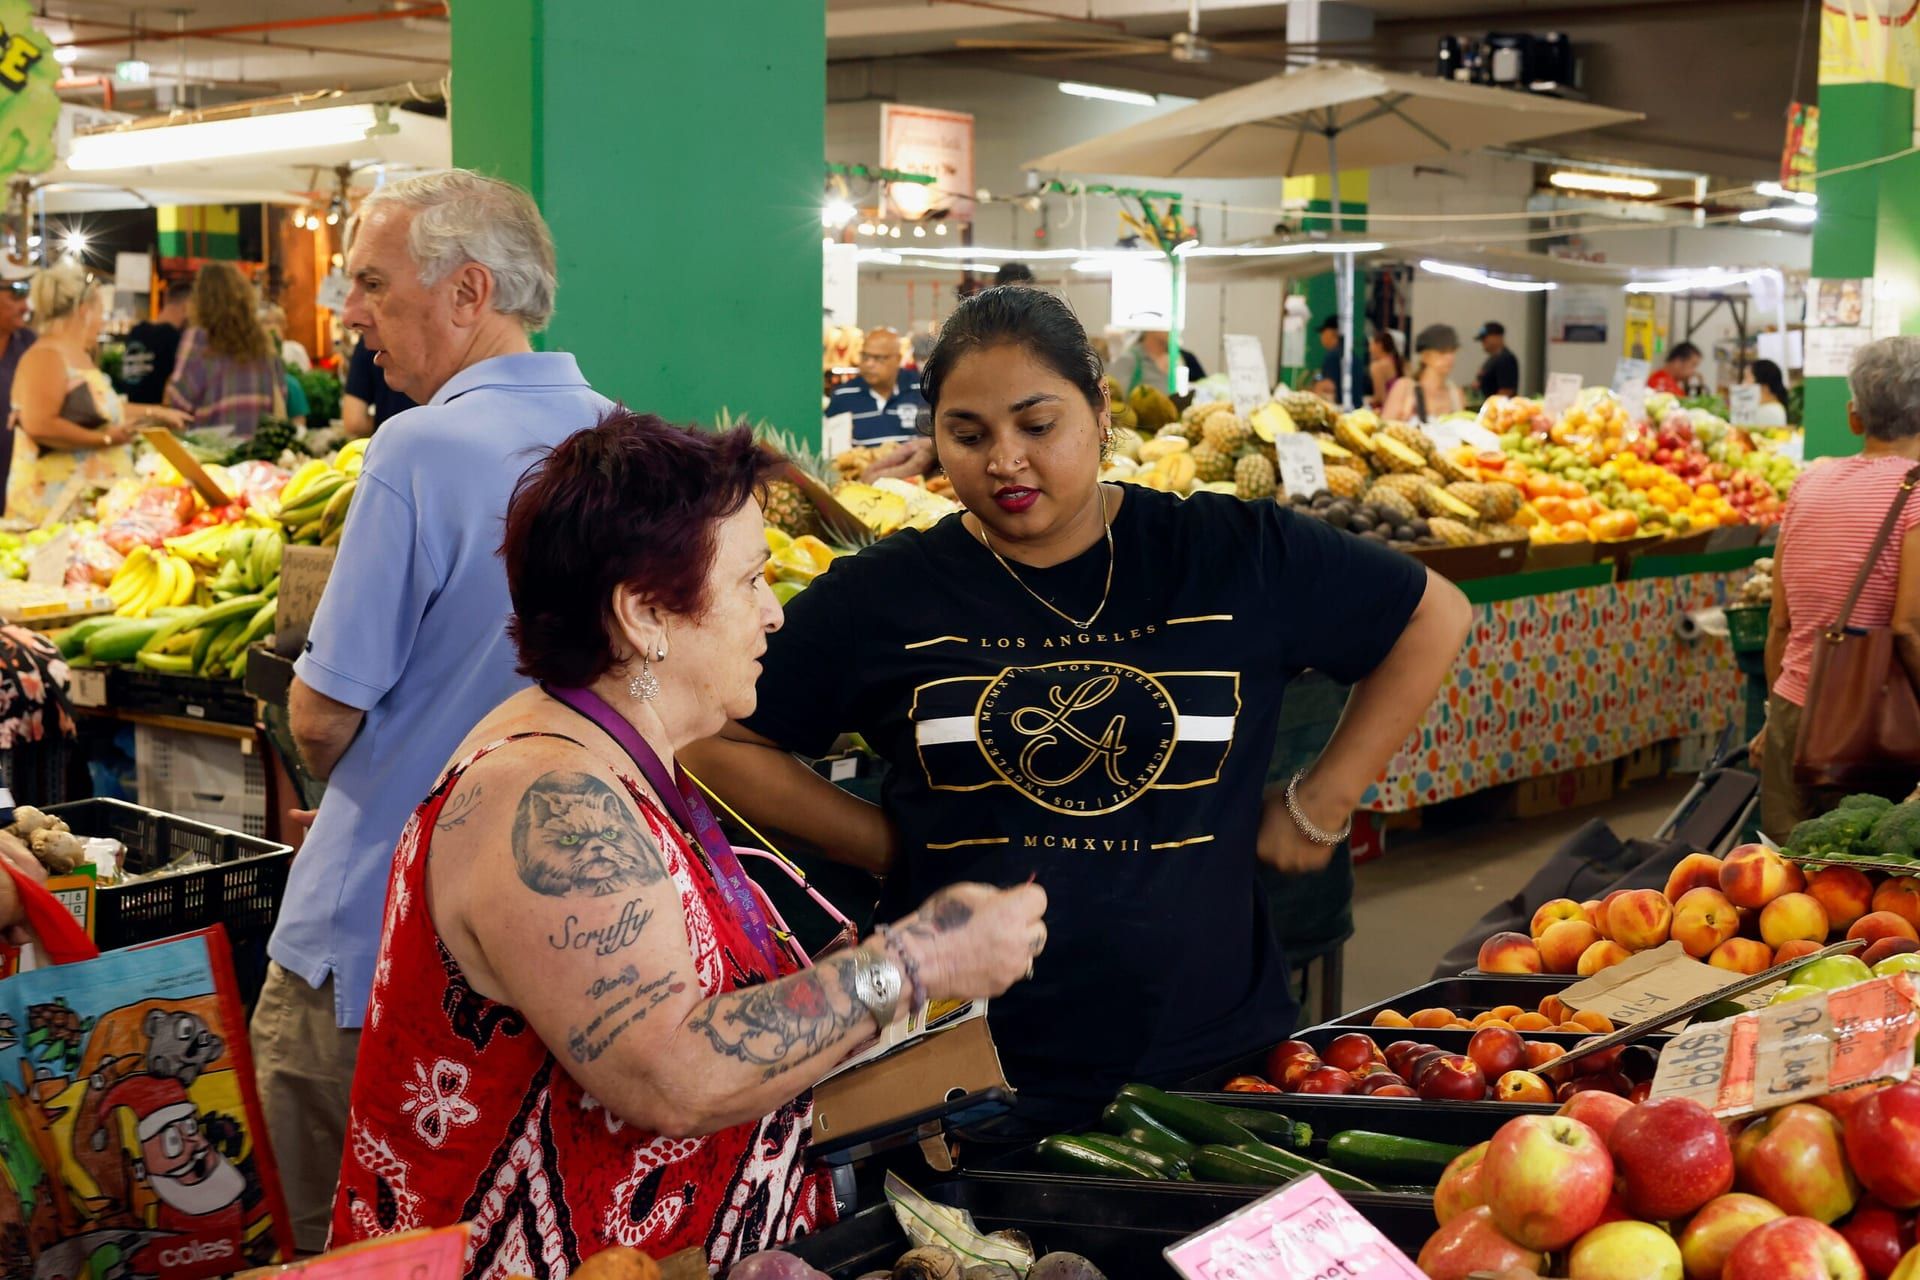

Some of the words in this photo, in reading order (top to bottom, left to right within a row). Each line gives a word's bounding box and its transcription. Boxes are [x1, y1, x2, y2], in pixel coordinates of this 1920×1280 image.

[980, 637, 1026, 648] LOS
[1043, 624, 1156, 648] ANGELES
[1057, 664, 1091, 672] LOS
[1101, 665, 1169, 710] ANGELES
[983, 738, 1046, 797] ANGELES
[1111, 738, 1171, 804] MCMXVII
[1053, 796, 1086, 811] LOS
[1023, 835, 1139, 851] MCMXVII
[549, 898, 654, 956] Scruffy
[158, 1237, 234, 1268] coles
